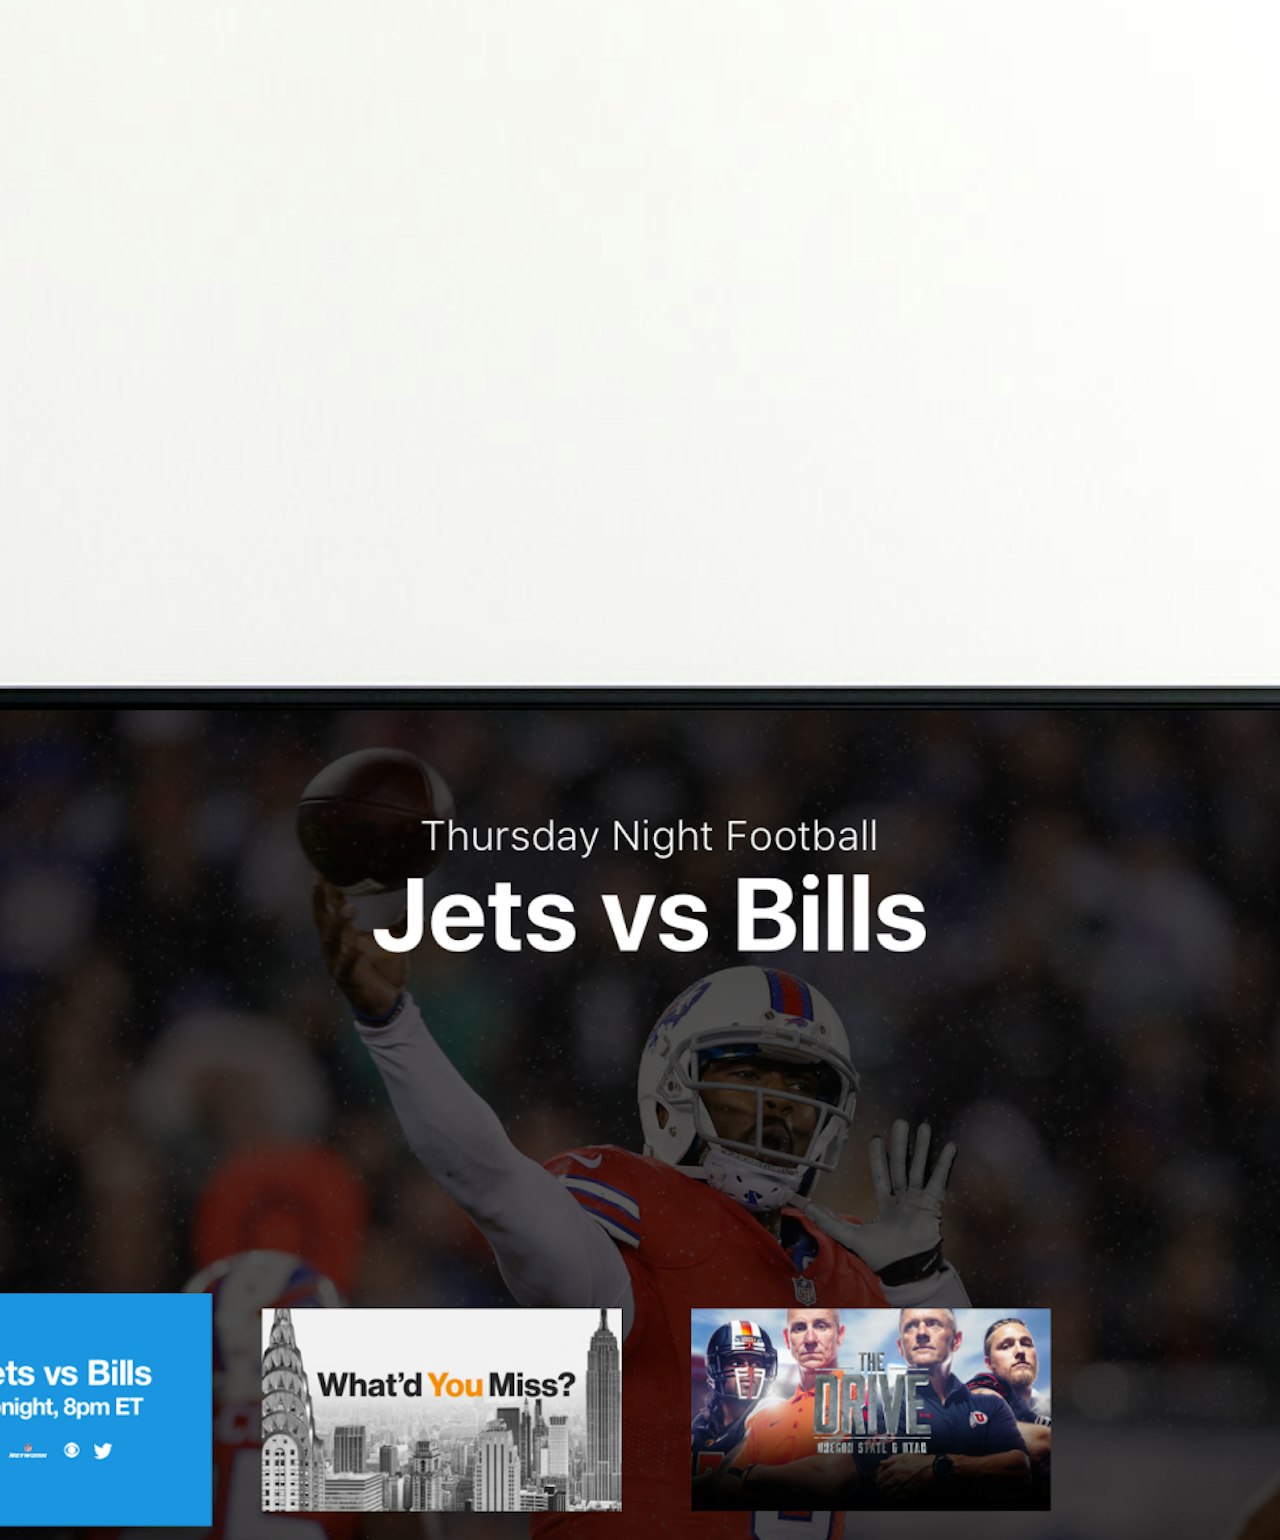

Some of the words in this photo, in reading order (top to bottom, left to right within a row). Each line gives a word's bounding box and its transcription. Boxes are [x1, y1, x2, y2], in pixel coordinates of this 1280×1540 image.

[422, 819, 599, 858] Thursday
[613, 820, 713, 859] Night
[729, 819, 875, 850] Football
[373, 877, 576, 952] Jets
[602, 895, 708, 951] vs
[739, 874, 925, 951] Bills
[44, 1366, 78, 1386] vs
[88, 1359, 152, 1386] Bills
[858, 1352, 885, 1372] THE
[427, 1372, 484, 1397] You
[489, 1372, 577, 1397] Miss?
[64, 1397, 110, 1420] 8pm
[116, 1397, 144, 1415] ET
[814, 1374, 932, 1435] DRIVE
